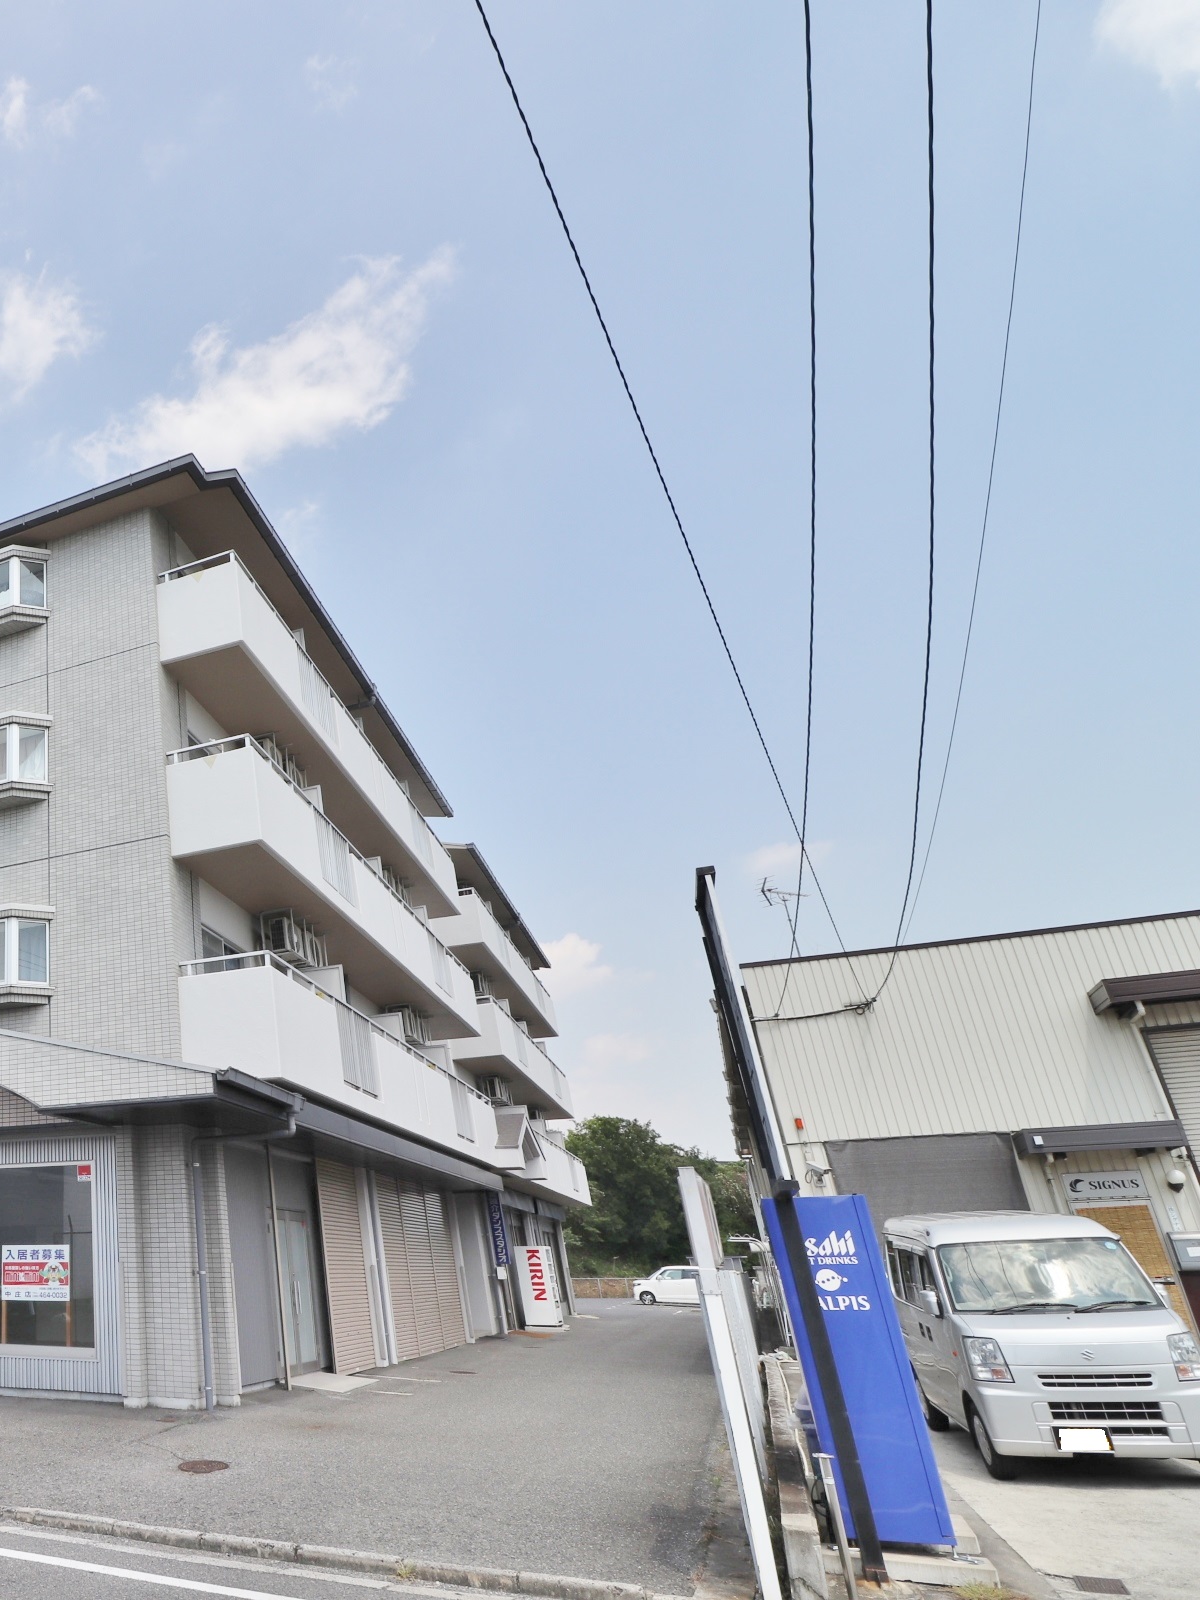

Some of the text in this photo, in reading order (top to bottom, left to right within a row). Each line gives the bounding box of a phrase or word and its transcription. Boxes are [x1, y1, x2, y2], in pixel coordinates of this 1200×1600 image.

[1088, 1179, 1140, 1190] SIGNUS
[804, 1230, 856, 1256] sahi
[5, 1248, 65, 1260] 入居者募集
[817, 1256, 859, 1265] DRINKS
[526, 1249, 548, 1301] KIRIN
[817, 1295, 871, 1311] ALPIS
